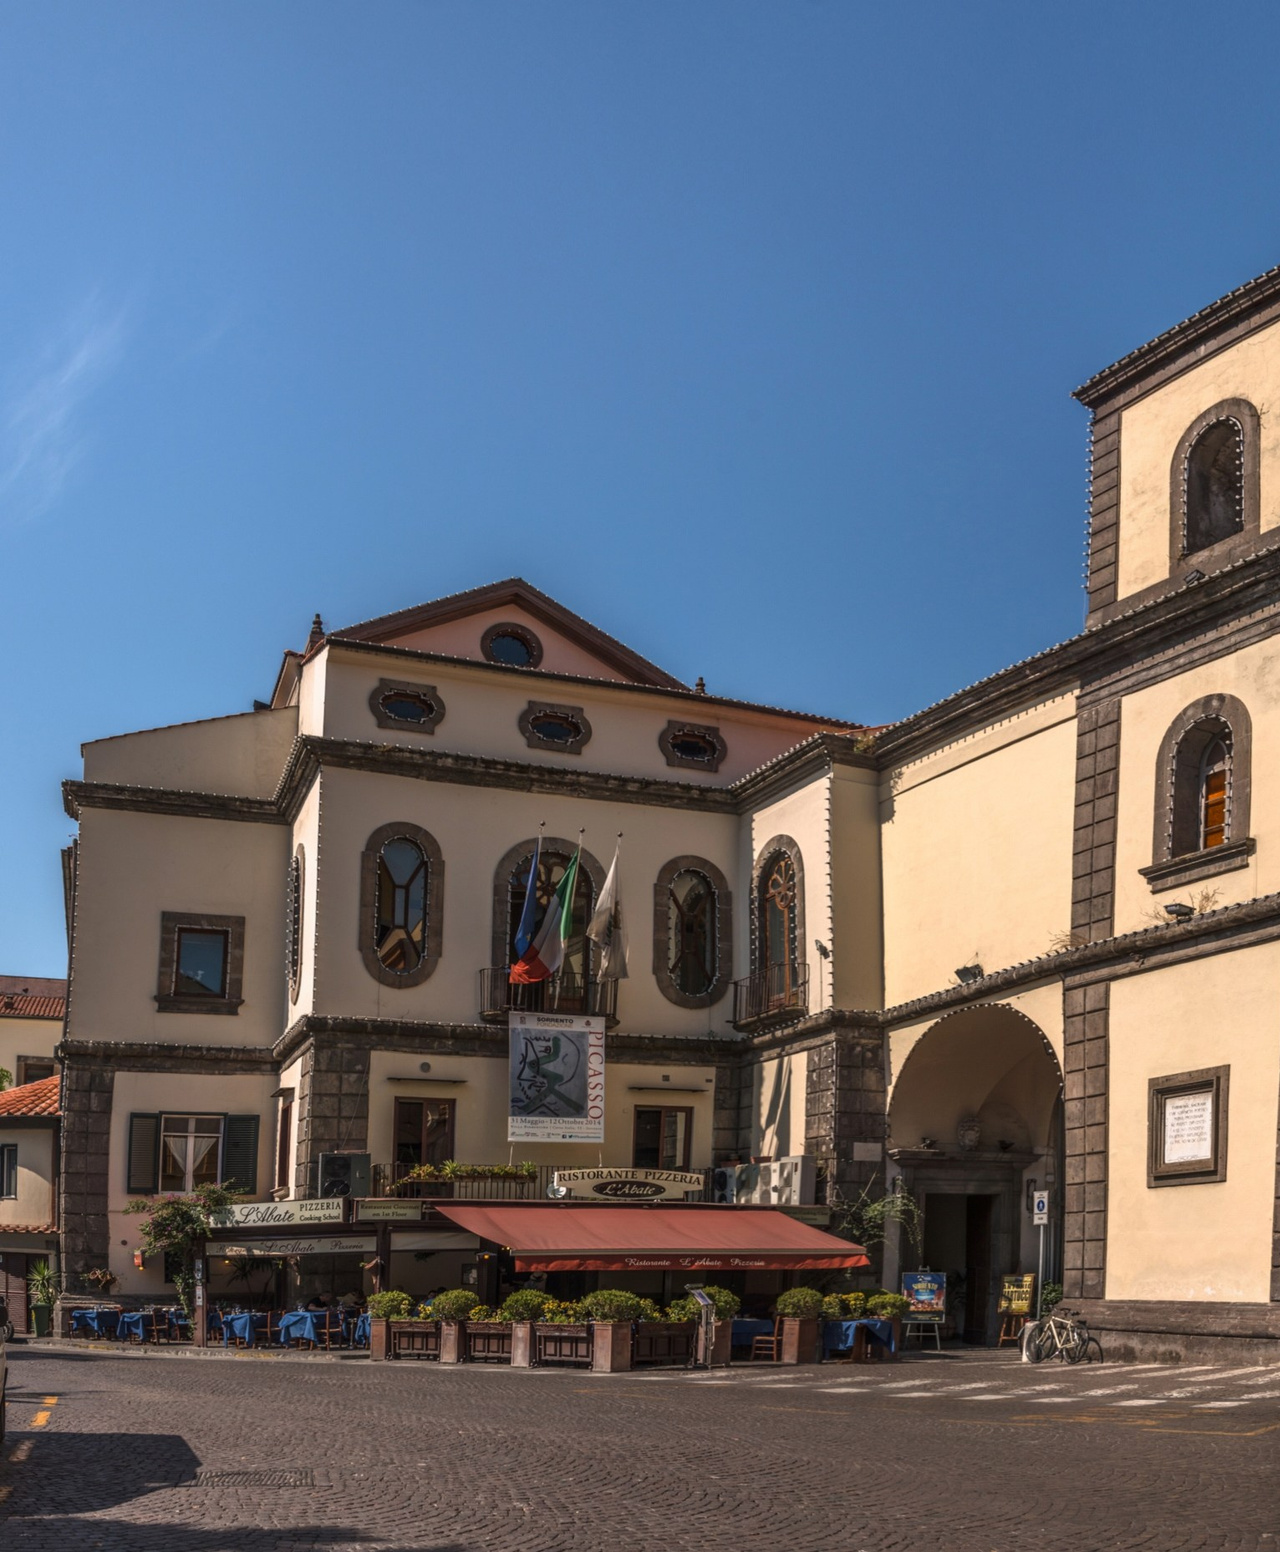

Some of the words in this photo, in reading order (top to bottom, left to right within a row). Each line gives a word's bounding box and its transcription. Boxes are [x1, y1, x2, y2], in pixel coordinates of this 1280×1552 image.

[588, 1030, 604, 1119] PICASSO
[520, 1118, 545, 1126] Maggio
[558, 1170, 638, 1182] RISTORANTE
[644, 1171, 701, 1185] PIZZERIA
[602, 1183, 656, 1195] L'Abate
[299, 1202, 341, 1212] PIZZERIA
[238, 1206, 295, 1224] L'Abate
[299, 1215, 322, 1223] Cooking
[322, 1213, 341, 1221] School
[330, 1240, 364, 1250] Pizzeria
[625, 1258, 671, 1266] Ristorante
[730, 1258, 766, 1266] Pizzeria
